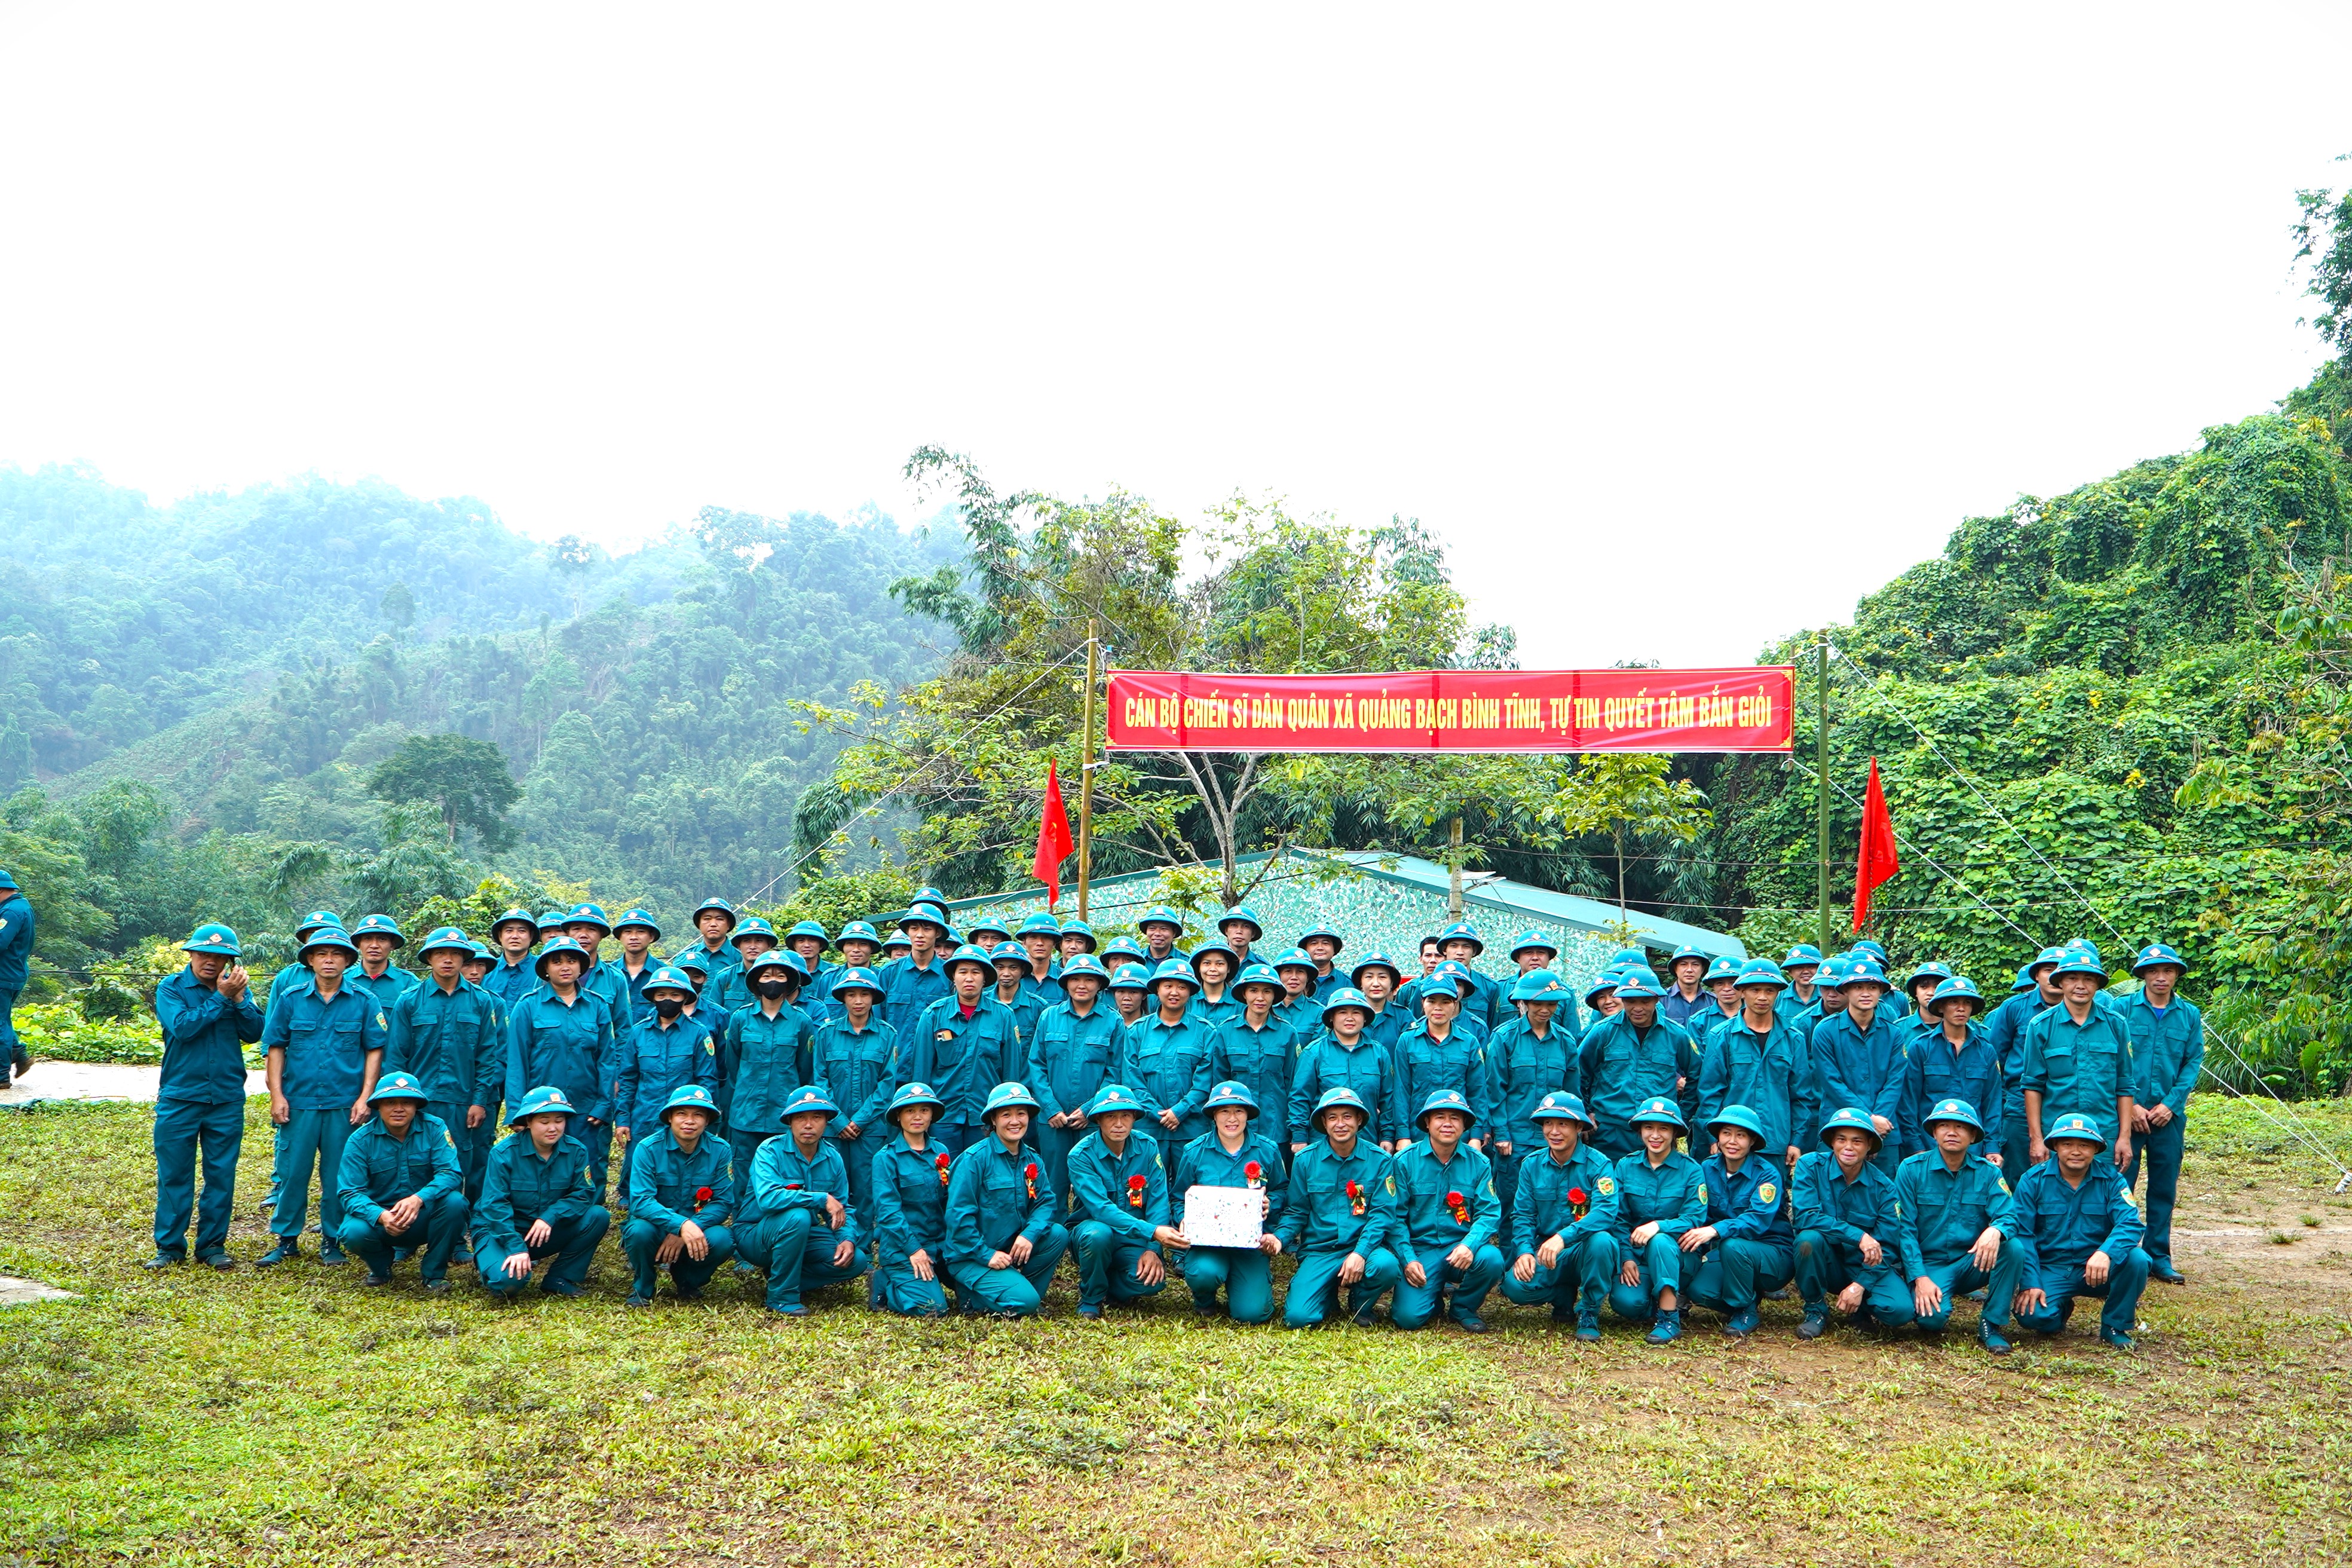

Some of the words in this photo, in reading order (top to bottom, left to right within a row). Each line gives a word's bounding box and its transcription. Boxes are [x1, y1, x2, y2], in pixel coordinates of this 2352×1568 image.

[1125, 691, 1156, 728] CÁN
[1159, 693, 1180, 734] BỘ
[1184, 689, 1229, 729] CHIẾN
[1232, 693, 1248, 729] SĨ
[1252, 693, 1284, 729] DÂN
[1287, 693, 1330, 732] QUÂN
[1333, 693, 1355, 729] XÃ
[1358, 688, 1411, 732] QUẢNG
[1415, 698, 1458, 736] BẠCH
[1462, 691, 1500, 729] BÌNH
[1503, 691, 1545, 733] TĨNH,
[1549, 694, 1572, 736] TỰ
[1574, 697, 1600, 729] TIN
[1604, 687, 1655, 732] QUYẾT
[1659, 690, 1694, 728] TÂM
[1699, 684, 1734, 728] BẮN
[1738, 685, 1772, 728] GIỎI
